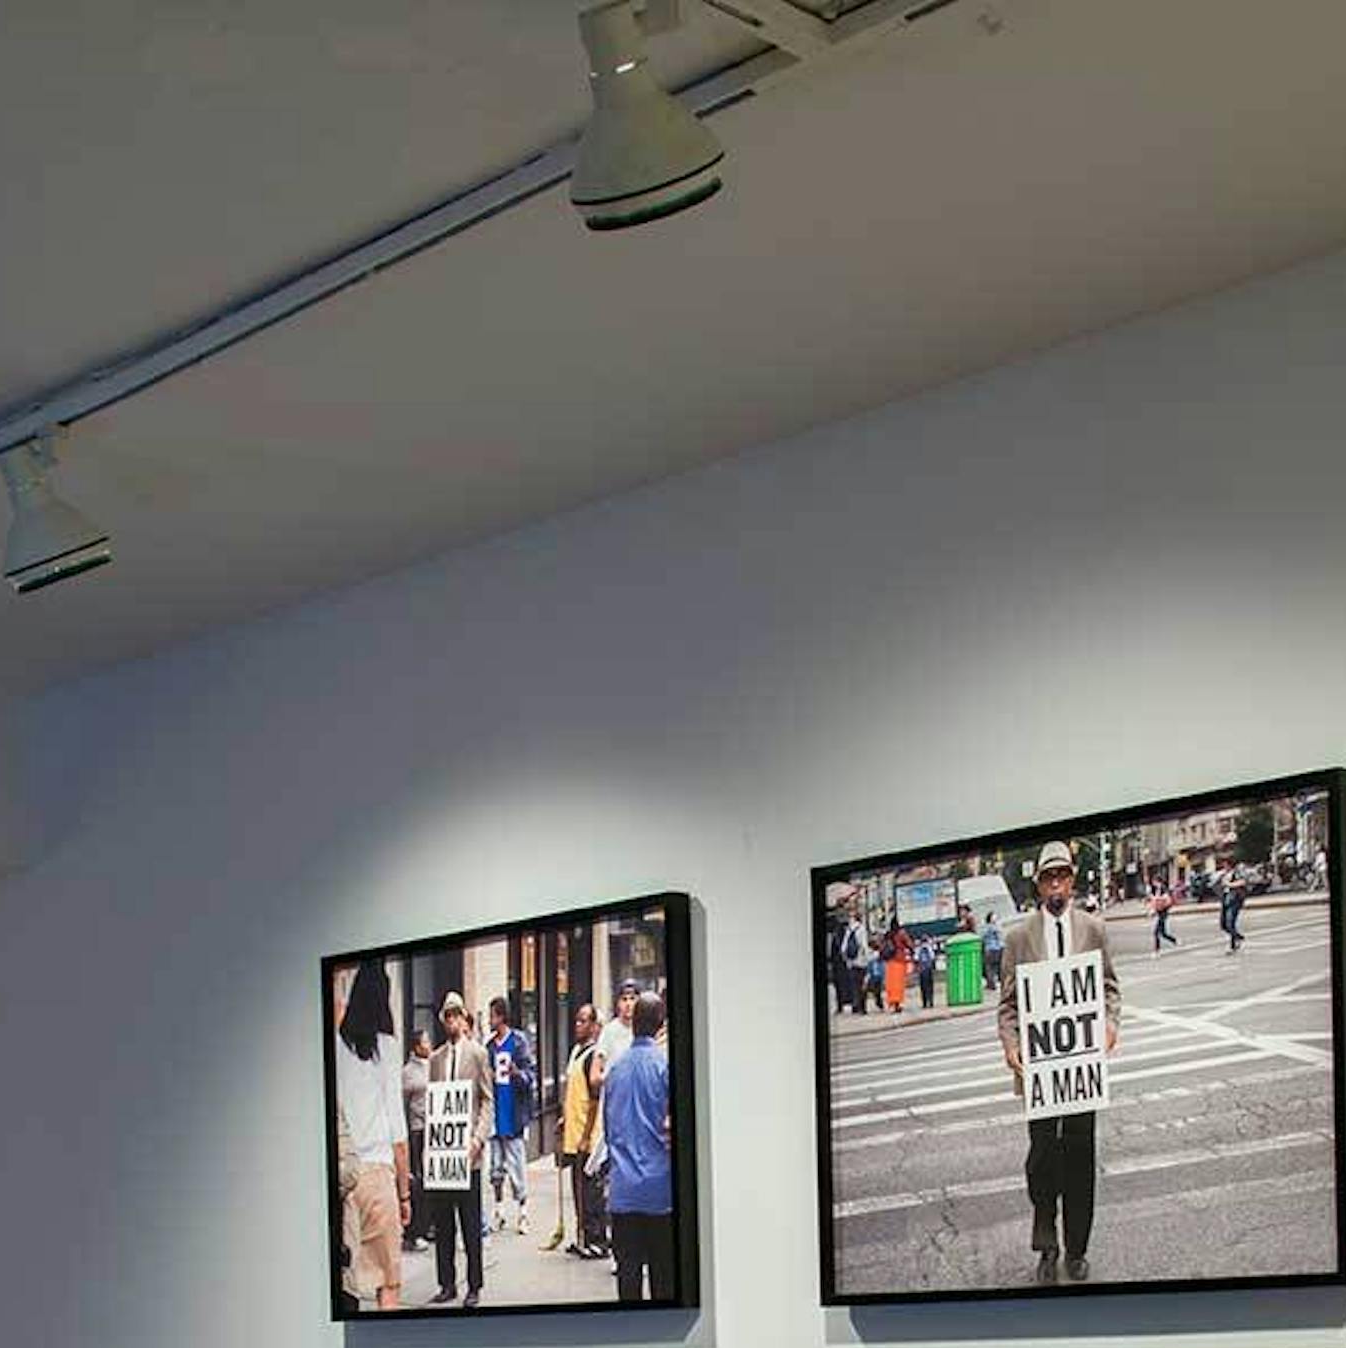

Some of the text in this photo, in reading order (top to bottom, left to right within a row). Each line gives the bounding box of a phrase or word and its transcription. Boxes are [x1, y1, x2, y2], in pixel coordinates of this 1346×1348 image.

[1024, 965, 1096, 1013] I AM
[1028, 1012, 1097, 1057] NOT
[429, 1088, 468, 1116] I AM
[1032, 1062, 1102, 1108] A MAN
[429, 1121, 467, 1148] NOT
[428, 1156, 468, 1181] A MAN
